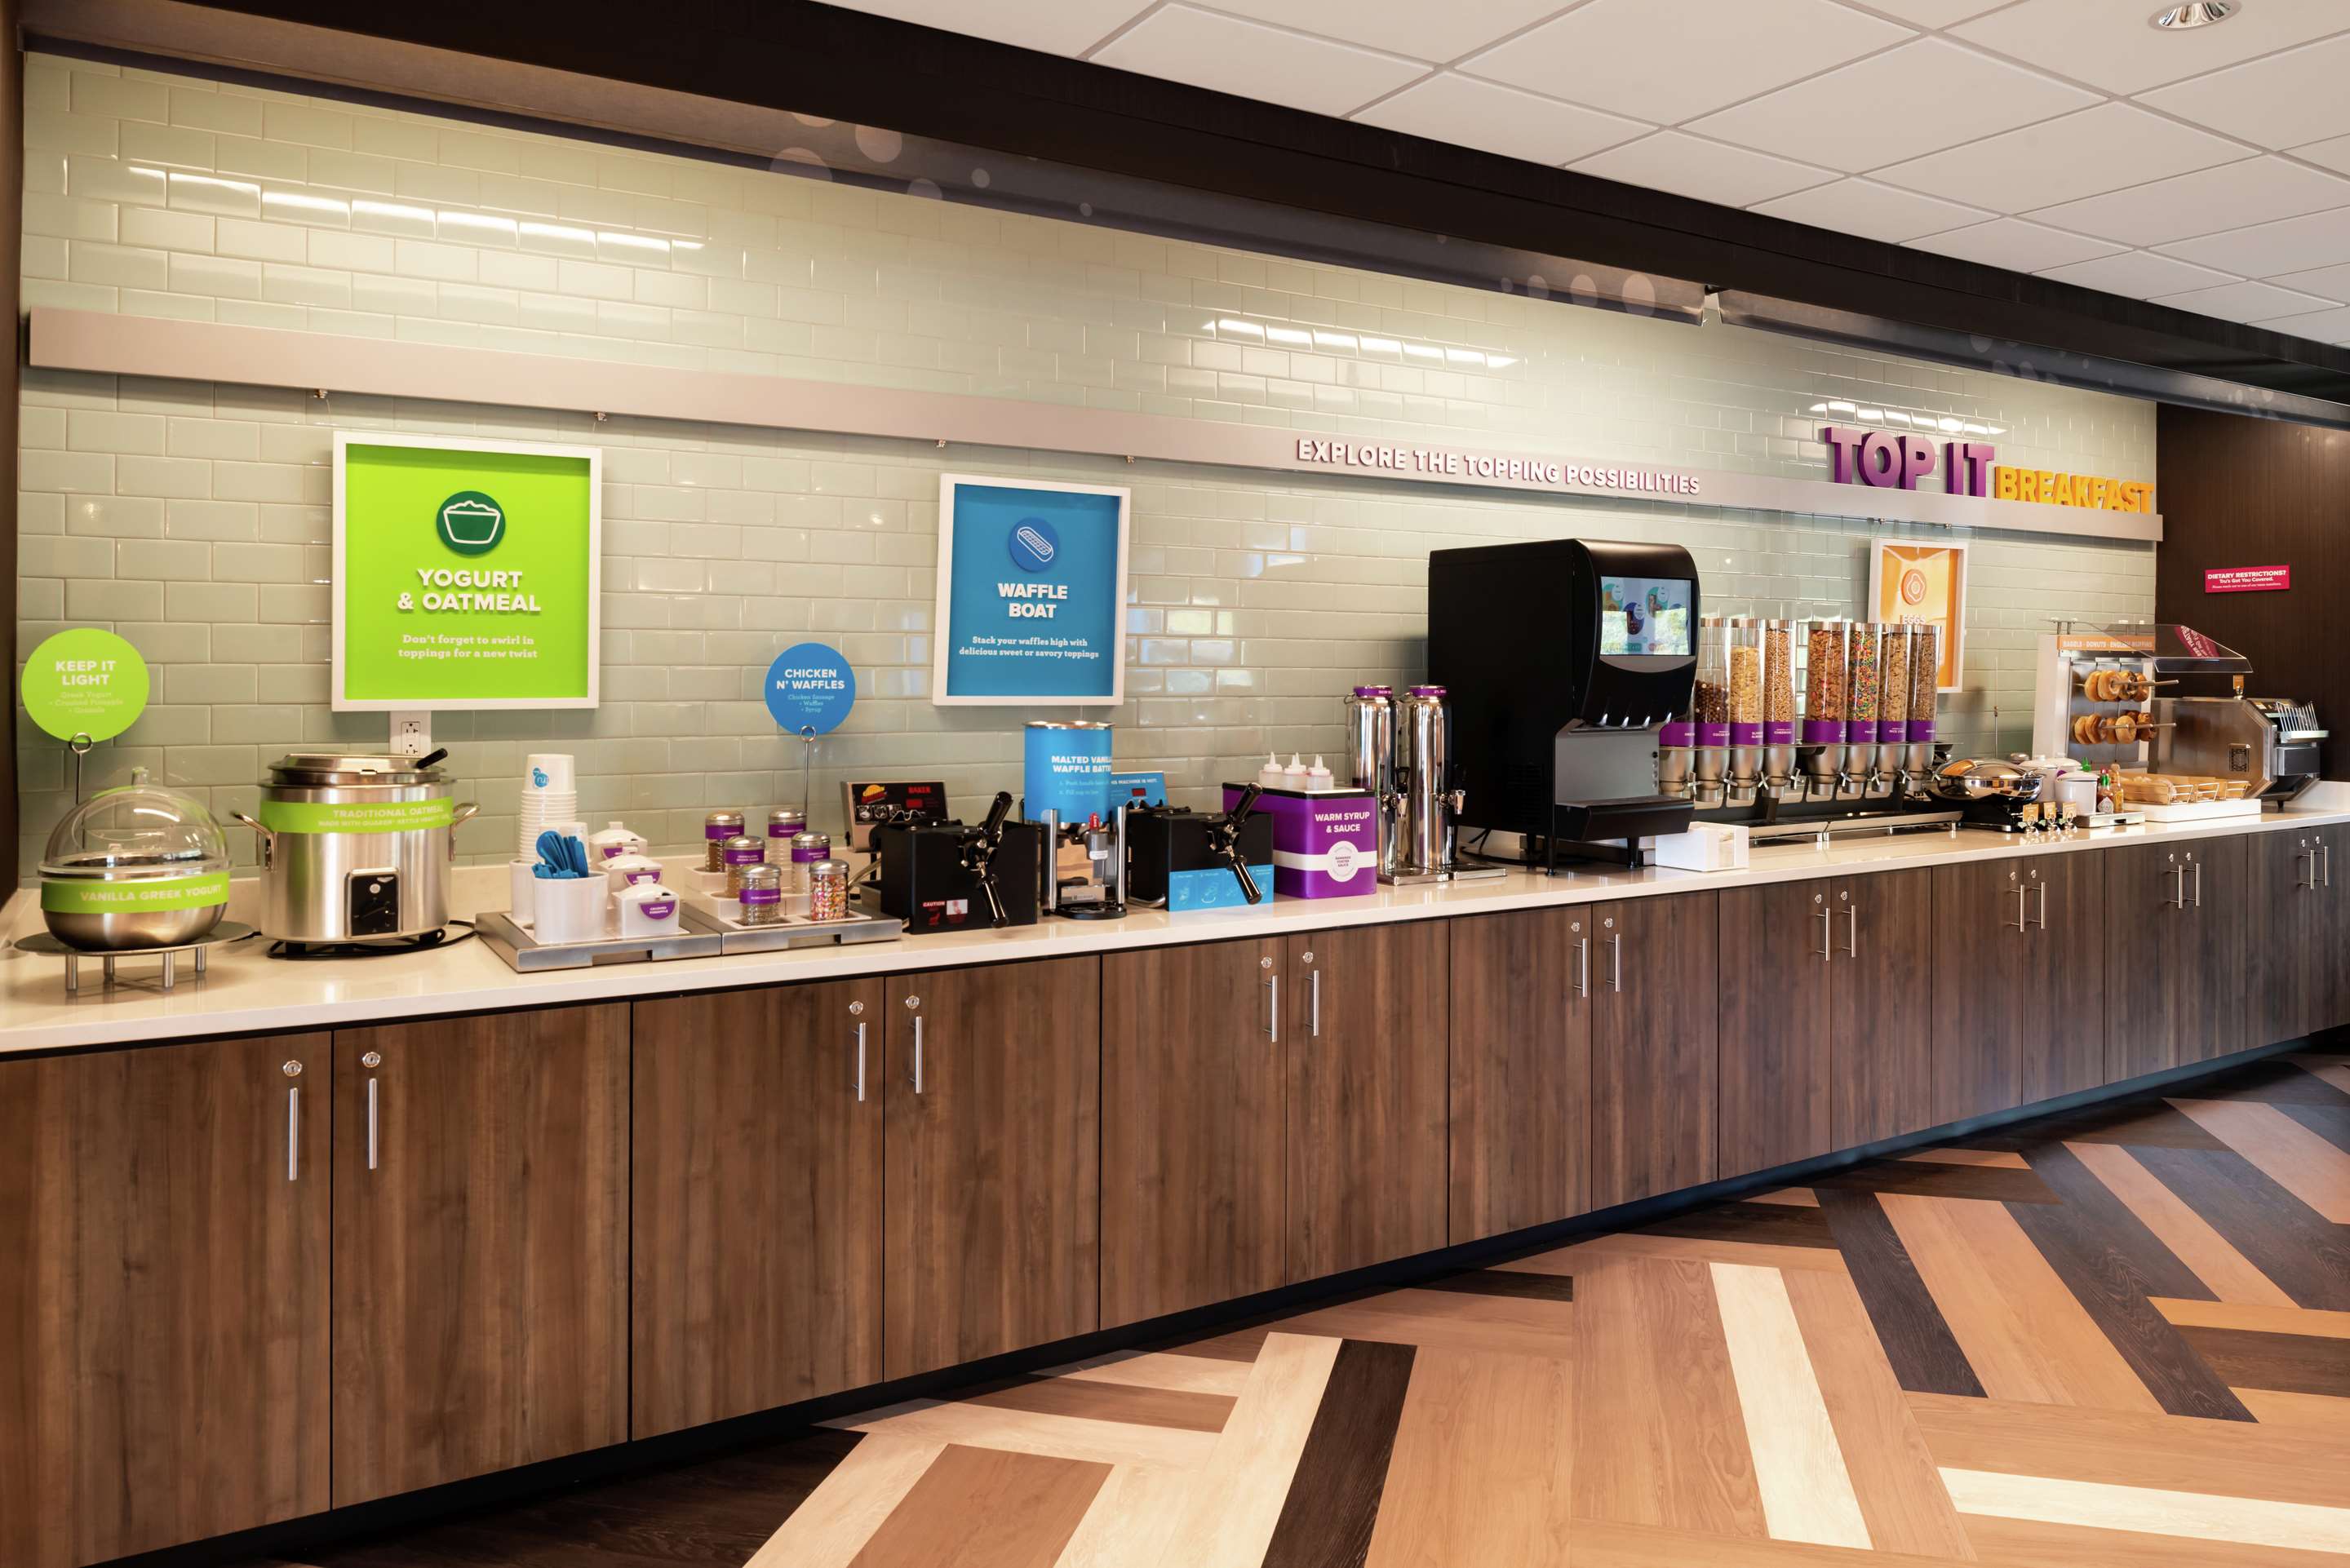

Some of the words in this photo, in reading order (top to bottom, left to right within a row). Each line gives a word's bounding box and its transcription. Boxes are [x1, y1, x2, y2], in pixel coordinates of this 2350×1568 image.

[1297, 438, 1405, 470] EXPLORE
[1413, 450, 1457, 474] THE
[1465, 454, 1560, 484] TOPPING
[1565, 463, 1700, 494] POSSIBILITIES
[1825, 427, 1935, 490] TOP
[1947, 441, 1995, 498] IT
[1994, 465, 2154, 515] BREAKFAST
[417, 569, 522, 588] YOGURT
[2235, 569, 2286, 578] RESTRICTIONS?
[997, 582, 1068, 600] WAFFLE
[397, 592, 414, 610] &
[423, 592, 541, 612] OATMEAL
[1009, 602, 1057, 618] BOAT
[1901, 614, 1927, 626] EGGS
[402, 634, 436, 644] Don't
[438, 634, 474, 646] forget
[477, 636, 489, 644] to
[491, 635, 520, 644] swirl
[522, 636, 534, 645] in
[972, 636, 996, 644] Stack
[997, 638, 1016, 646] your
[1018, 636, 1049, 645] waffles
[1050, 636, 1068, 648] high
[1070, 638, 1088, 646] with
[398, 649, 450, 659] toppings
[454, 648, 471, 658] for
[483, 650, 506, 658] new
[508, 649, 538, 658] twist
[959, 647, 997, 656] delicious
[999, 649, 1023, 657] sweet
[1035, 650, 1062, 658] savory
[1064, 650, 1099, 659] toppings
[55, 660, 97, 671] KEEP
[101, 659, 117, 671] IT
[784, 668, 837, 678] CHICKEN
[61, 674, 109, 686] LIGHT
[776, 680, 788, 689] N'
[791, 680, 845, 689] WAFFLES
[1051, 755, 1089, 764] MALTED
[1053, 765, 1090, 773] WAFFLE
[333, 808, 406, 818] TRADITIONAL
[1315, 813, 1342, 822] WARM
[1344, 811, 1370, 821] SYRUP
[1326, 825, 1332, 833] &
[1333, 824, 1361, 832] SAUCE
[80, 891, 135, 901] VANILLA
[140, 889, 182, 900] GREEK
[185, 884, 222, 897] YOGURT
